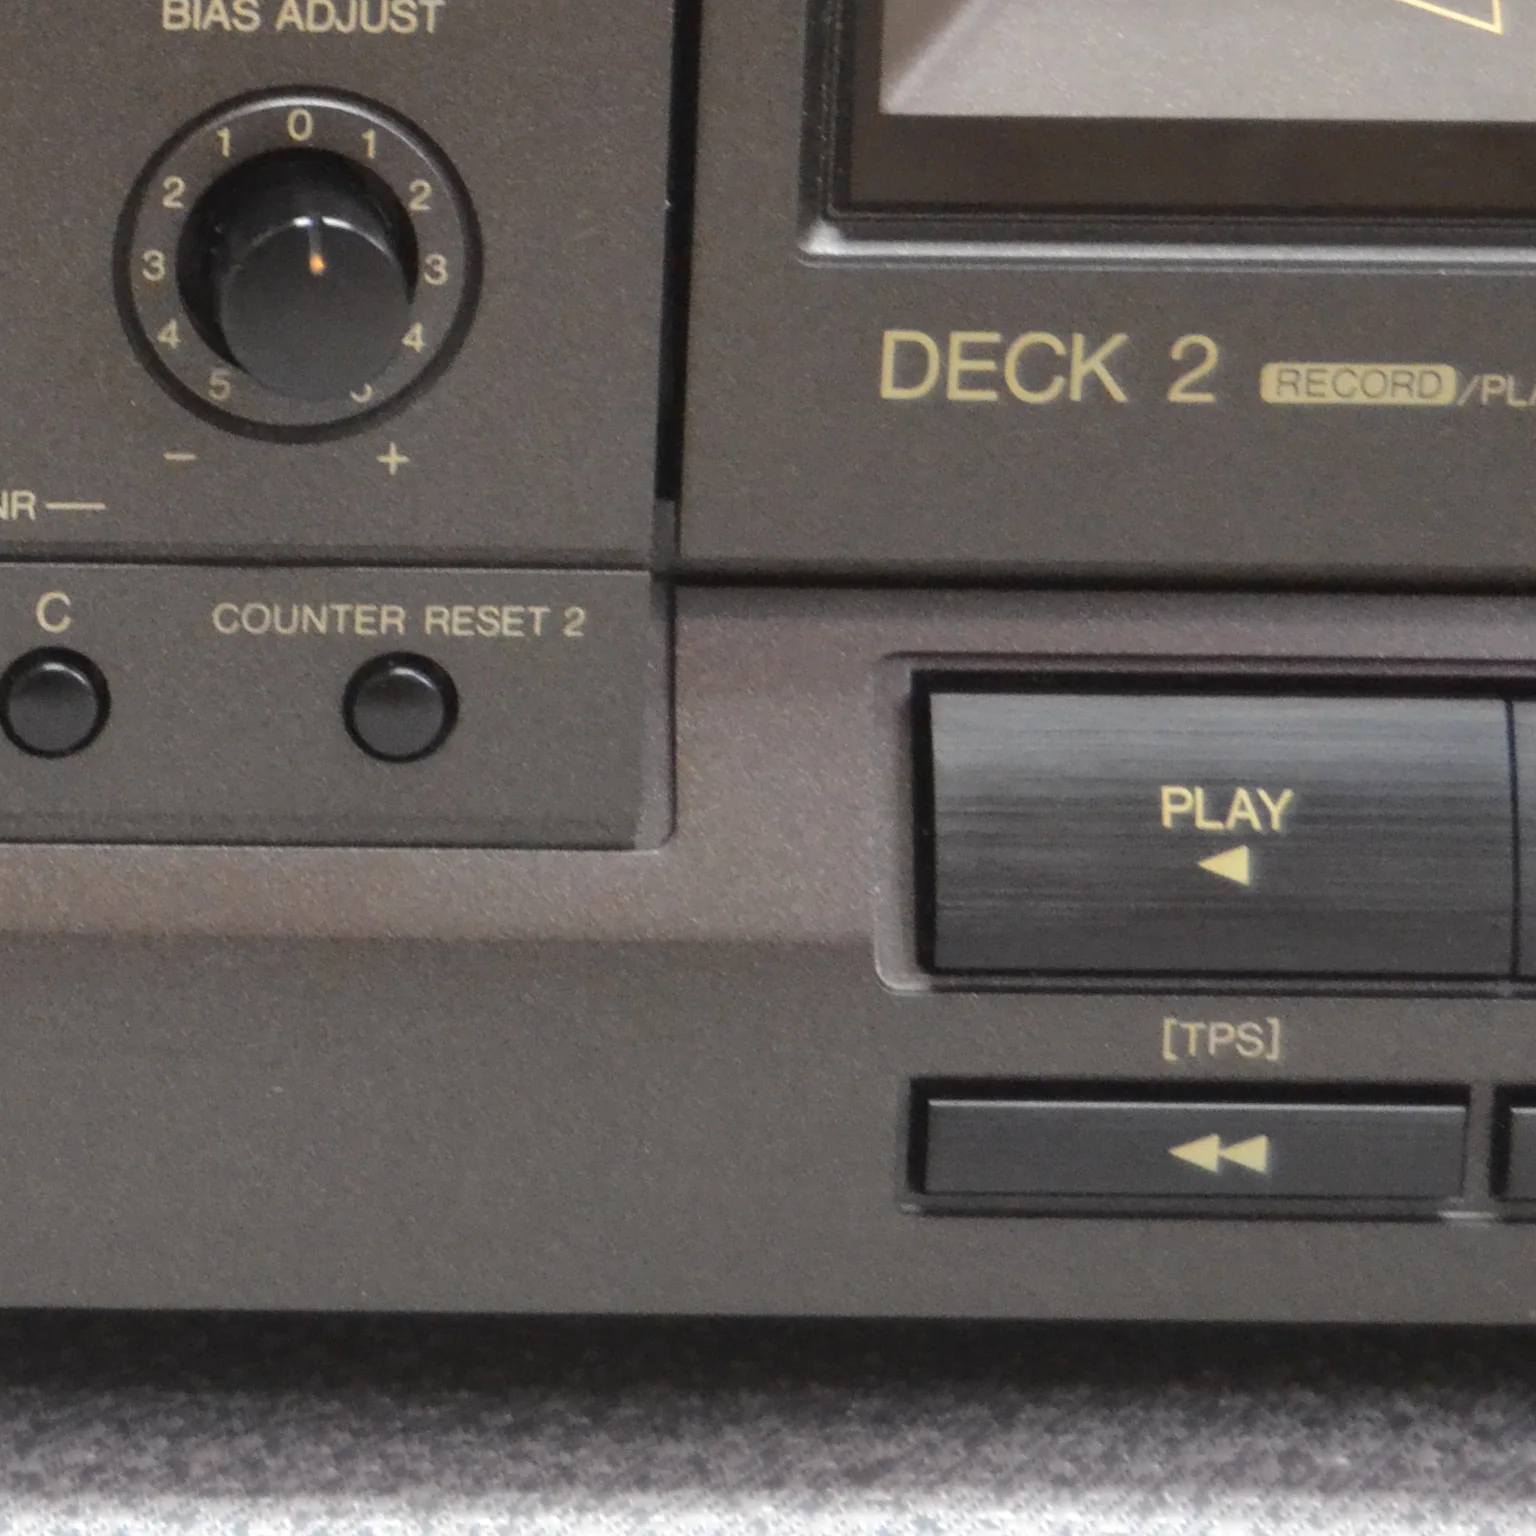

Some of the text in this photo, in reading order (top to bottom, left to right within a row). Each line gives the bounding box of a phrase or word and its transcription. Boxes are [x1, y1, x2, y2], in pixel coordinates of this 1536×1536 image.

[142, 108, 449, 402] 5 4 3 2 1 0 1 2 3 4
[879, 329, 1128, 404] DECK
[1167, 334, 1219, 404] 2
[35, 590, 72, 634] C
[211, 602, 587, 638] COUNTER RESET 2
[1160, 785, 1293, 831] PLAY
[1161, 1017, 1282, 1063] [TPS]
